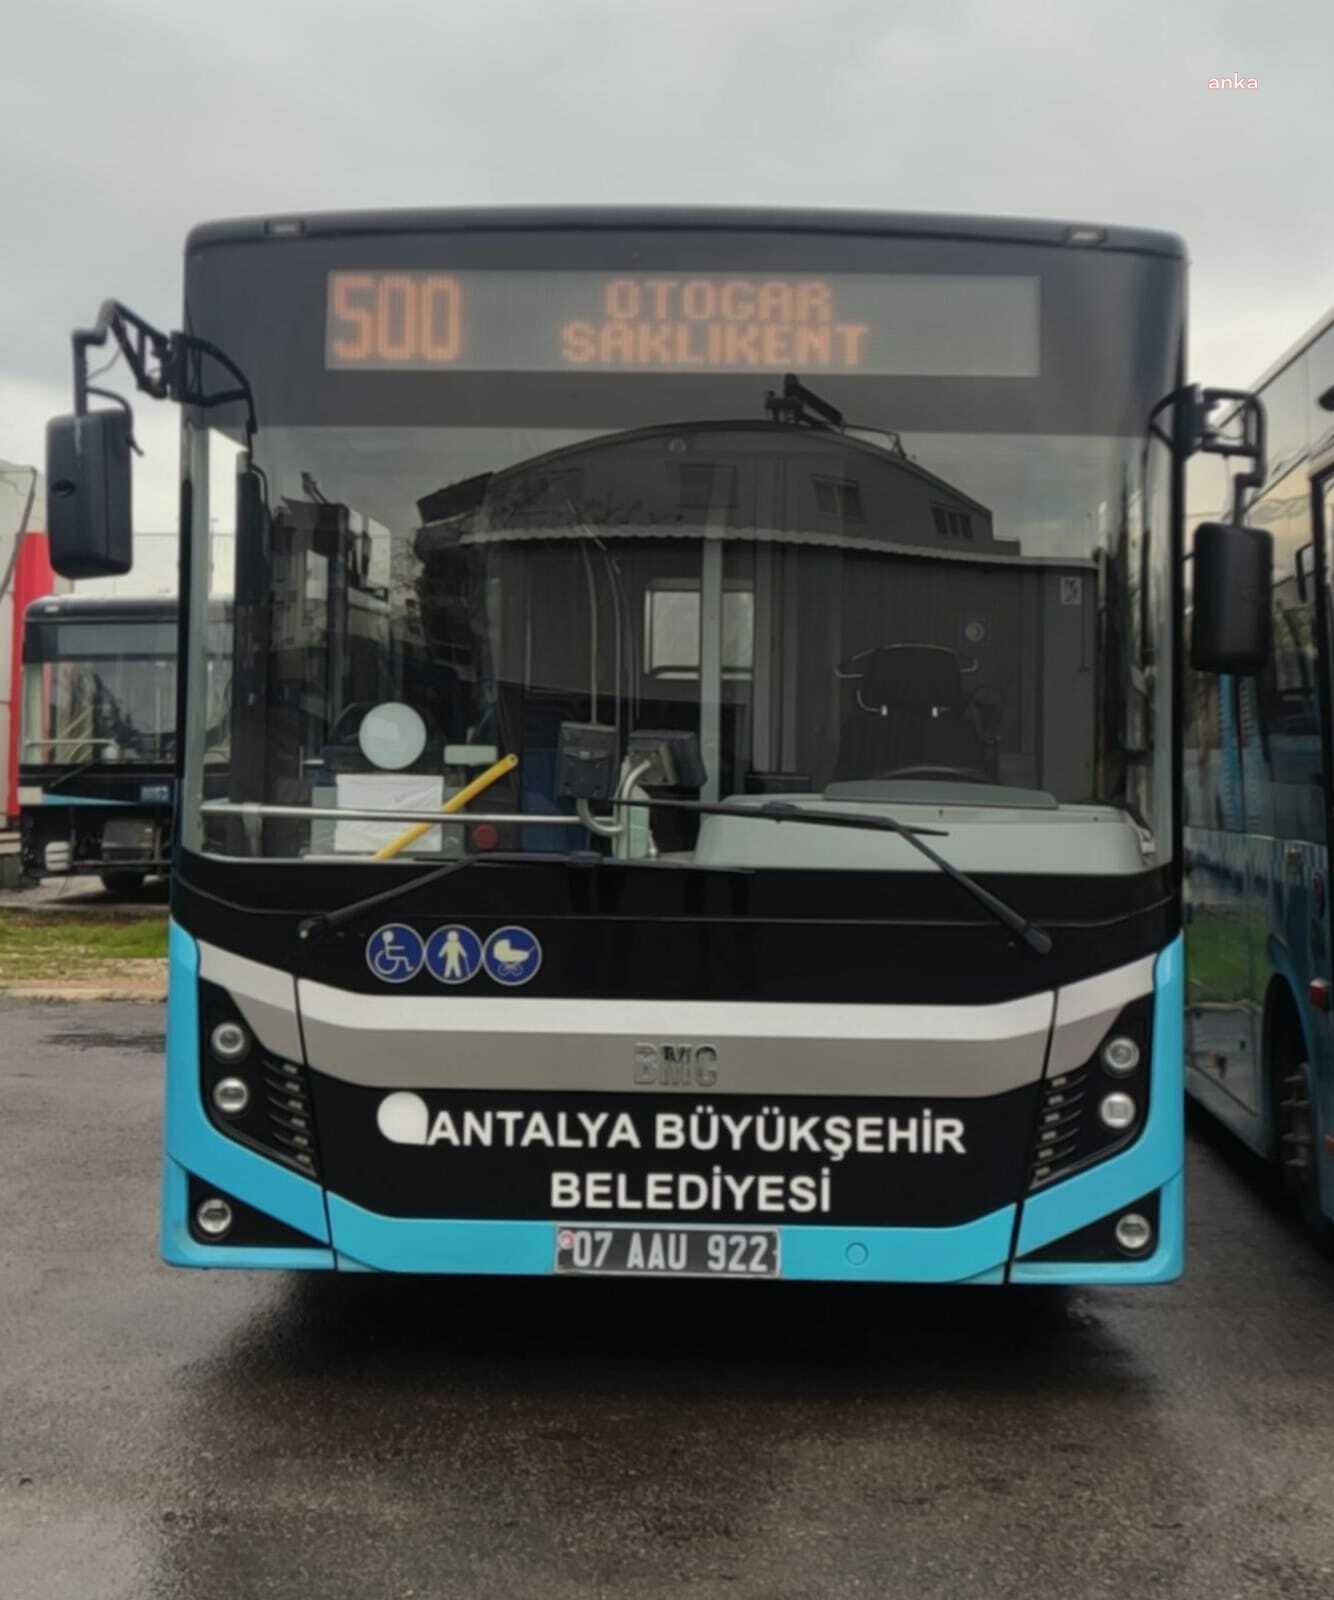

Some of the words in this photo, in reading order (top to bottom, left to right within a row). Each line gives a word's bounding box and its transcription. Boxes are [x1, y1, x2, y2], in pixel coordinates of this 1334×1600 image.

[334, 276, 461, 360] 500
[606, 281, 832, 321] OTOGAR
[563, 324, 867, 365] SAKLIKENT
[633, 1042, 718, 1086] BMC
[427, 1110, 640, 1148] ANTALYA
[655, 1106, 966, 1160] BÜYÜKŞEHİR
[551, 1165, 832, 1213] BELEDİYESİ
[572, 1231, 612, 1269] 07
[626, 1231, 688, 1270] AAU
[707, 1233, 769, 1273] 922
